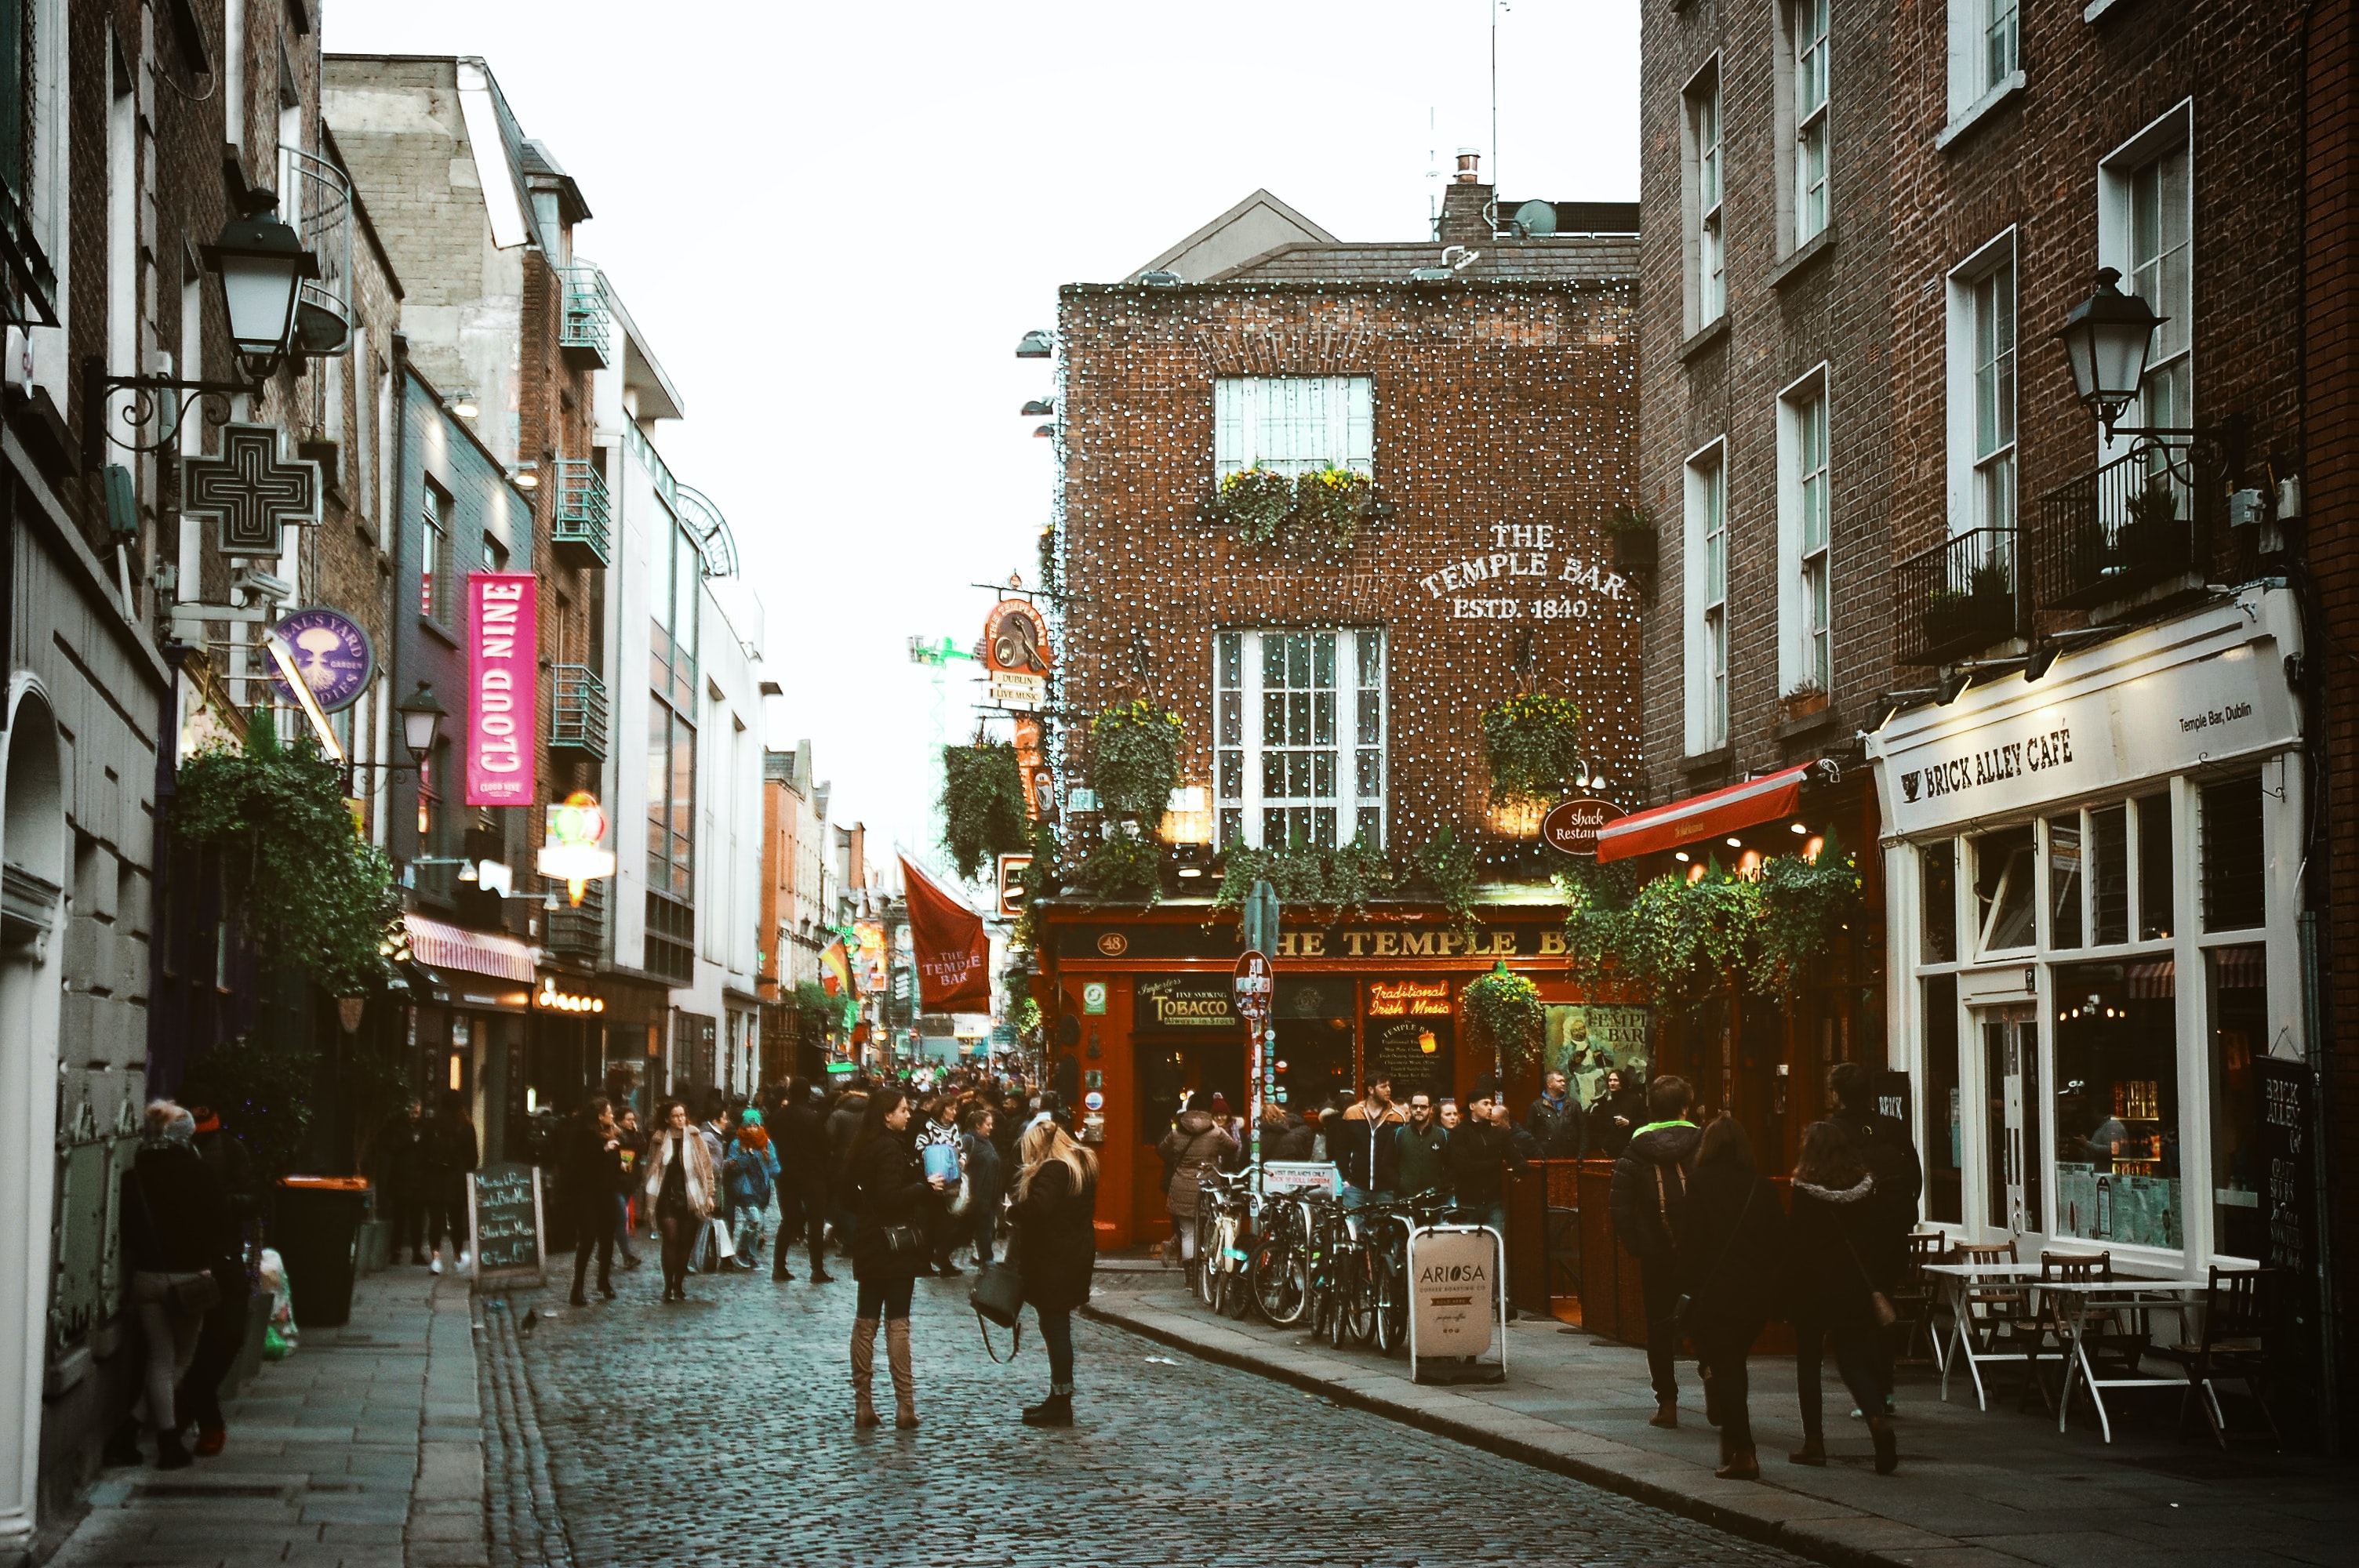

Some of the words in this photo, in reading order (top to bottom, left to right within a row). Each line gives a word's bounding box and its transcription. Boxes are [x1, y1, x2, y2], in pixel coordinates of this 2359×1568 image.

[1492, 524, 1554, 548] THE
[1419, 552, 1548, 599] TEMPLE
[1562, 557, 1626, 601] BAR
[1453, 598, 1523, 619] ESTD.
[1533, 599, 1588, 618] 1840
[482, 583, 524, 659] NINE
[989, 614, 1001, 640] THE
[998, 601, 1037, 621] TEMPLE
[1034, 619, 1046, 646] BAR
[278, 615, 324, 641] EAL'S
[330, 618, 362, 657] YARD
[1002, 674, 1033, 684] DUBLIN
[997, 689, 1013, 698] LIVE
[1016, 691, 1039, 701] MUSIC
[480, 669, 522, 773] CLOUD
[2179, 713, 2207, 732] Temple
[2208, 710, 2225, 724] Bar,
[2225, 702, 2252, 721] Dublin
[1925, 757, 1972, 798] BRICK
[1976, 742, 2022, 786] ALLEY
[2026, 717, 2073, 772] CAFÉ
[1572, 808, 1604, 826] Shack
[1556, 828, 1594, 840] Restau
[1103, 937, 1121, 949] 48
[1343, 931, 1517, 956] TEMPLE
[922, 955, 981, 976] TEMPLE
[940, 951, 965, 961] THE
[941, 971, 968, 986] BAR
[1371, 983, 1447, 1000] Traditional
[1369, 1000, 1404, 1015] Irish
[1410, 1000, 1449, 1014] Music
[1383, 1023, 1416, 1039] TEMPLE
[1608, 1028, 1645, 1044] BAR
[2266, 1078, 2299, 1105] BRICK
[2266, 1102, 2301, 1128] ALLEY
[1420, 1265, 1485, 1283] ARIOSA
